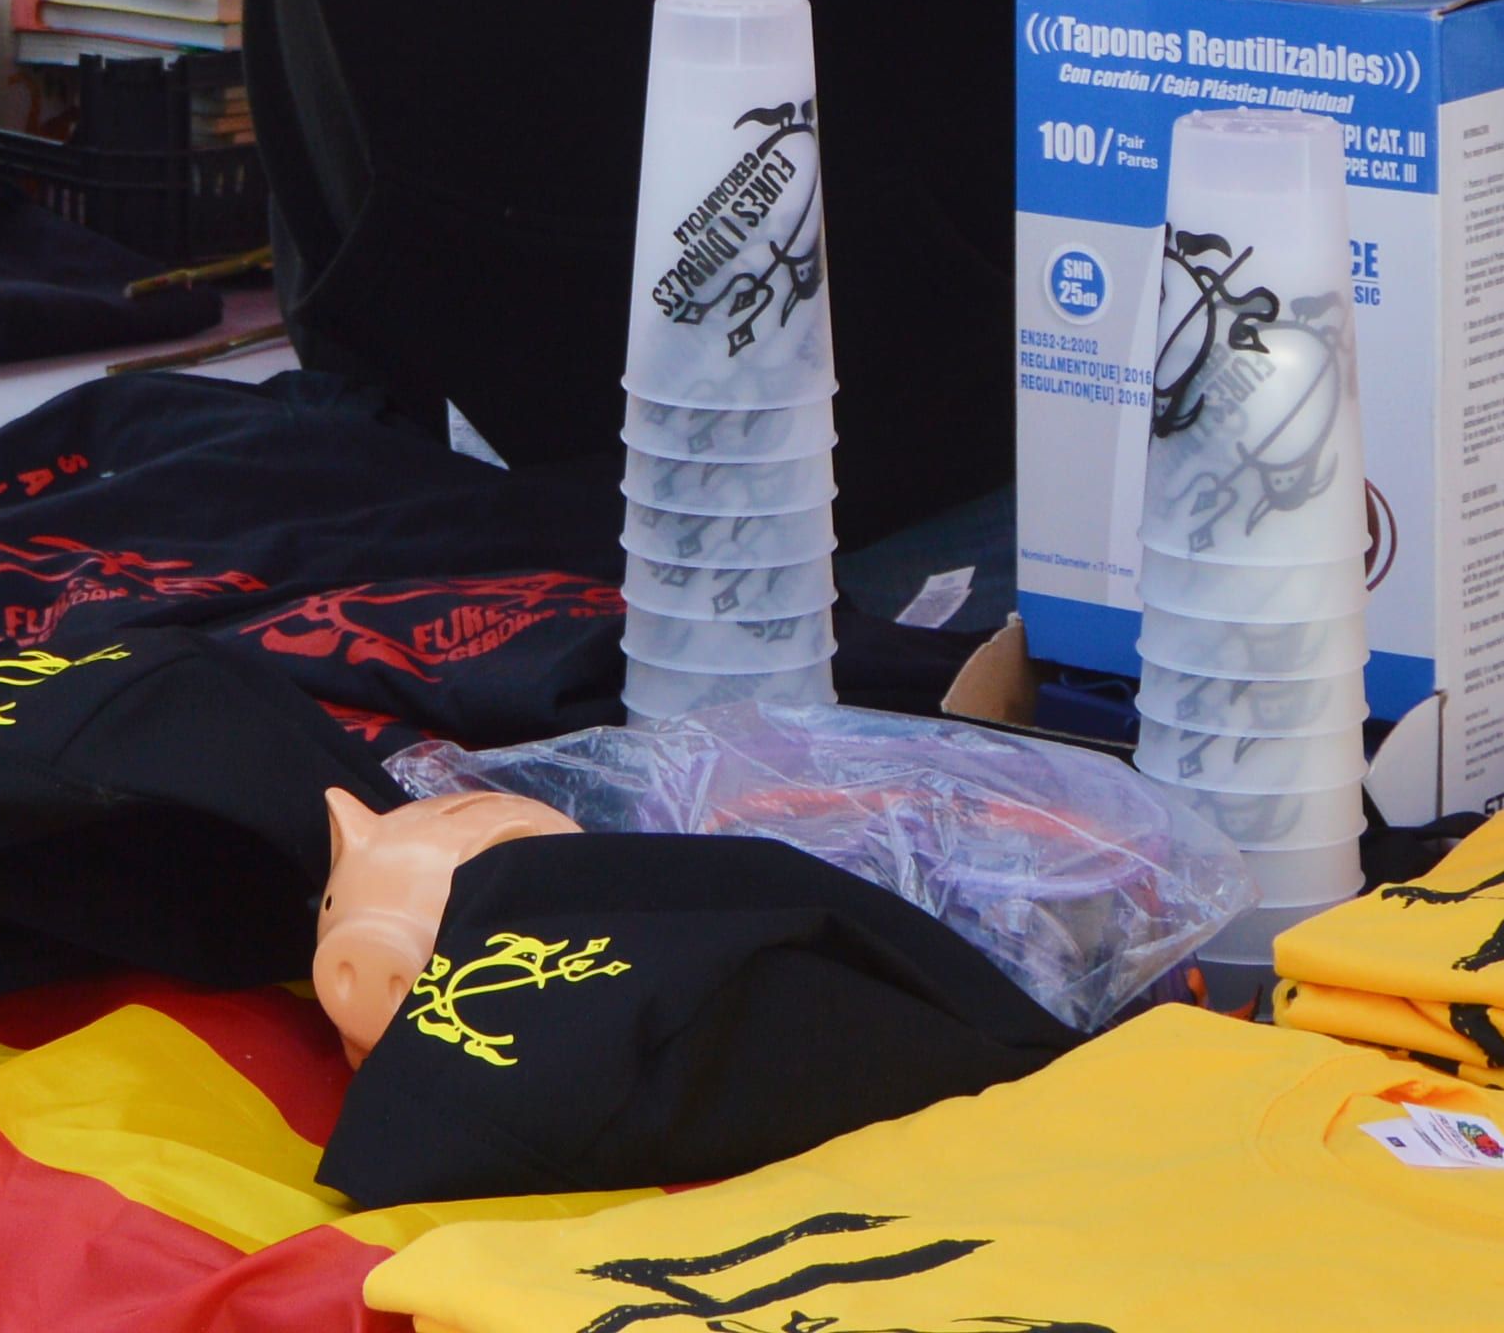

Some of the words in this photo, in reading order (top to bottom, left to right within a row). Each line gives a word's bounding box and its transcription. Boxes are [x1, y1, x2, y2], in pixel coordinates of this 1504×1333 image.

[1059, 63, 1092, 85] Con
[1094, 68, 1150, 92] cordón
[1161, 74, 1199, 98] Caja
[1201, 79, 1267, 105] Plástica
[1268, 85, 1355, 115] Individual
[1117, 132, 1145, 150] Pair
[1366, 126, 1404, 155] CAT.
[1407, 131, 1426, 158] III
[1117, 149, 1159, 170] Pares
[1371, 160, 1401, 182] CAT.
[1403, 164, 1418, 183] III
[730, 149, 797, 228] FURES
[652, 226, 741, 318] DIABLES
[1062, 258, 1094, 281] SNR
[1058, 281, 1098, 308] 25dB
[1020, 328, 1099, 355] EN352-2:2002
[1020, 350, 1121, 384] REGLAMENTO[UE]
[1020, 373, 1115, 406] REGULATION[EU]
